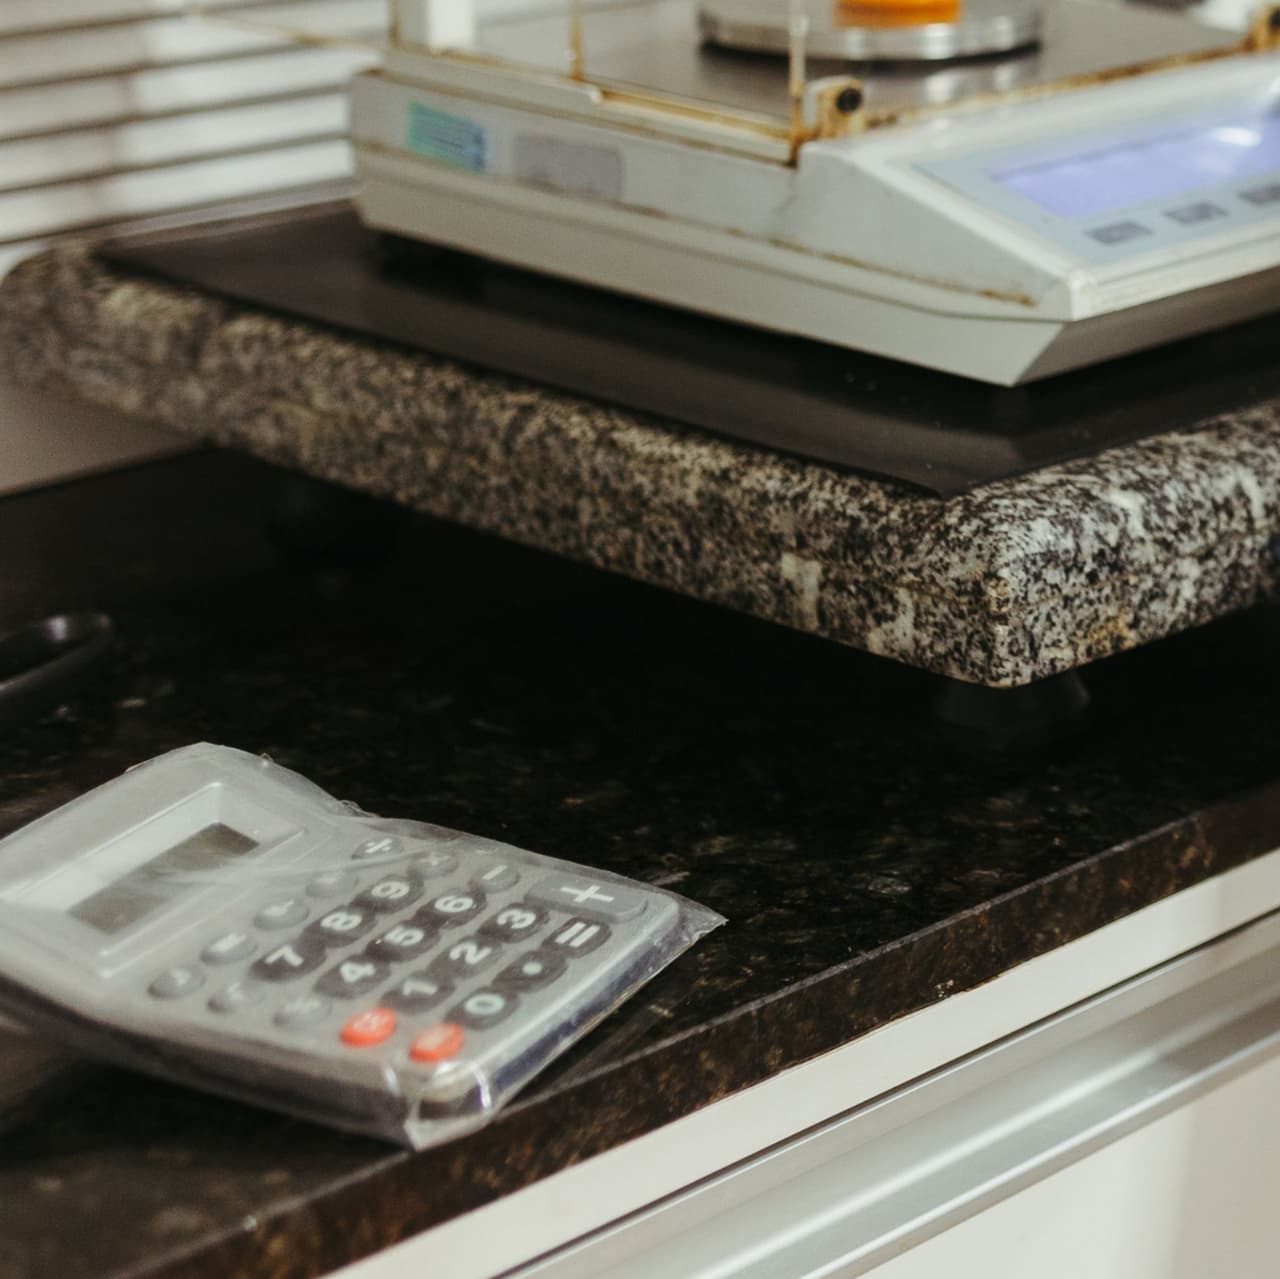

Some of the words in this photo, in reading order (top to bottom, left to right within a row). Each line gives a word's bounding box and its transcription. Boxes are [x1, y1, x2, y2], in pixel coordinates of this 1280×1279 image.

[263, 944, 304, 967] 7
[319, 911, 363, 932] 8
[370, 880, 411, 900] 9
[339, 962, 376, 983] 4
[383, 925, 425, 947] 5
[433, 894, 475, 914] 6
[402, 980, 438, 996] 1
[449, 940, 492, 965] 2
[496, 908, 537, 930] 3
[463, 992, 505, 1016] 0
